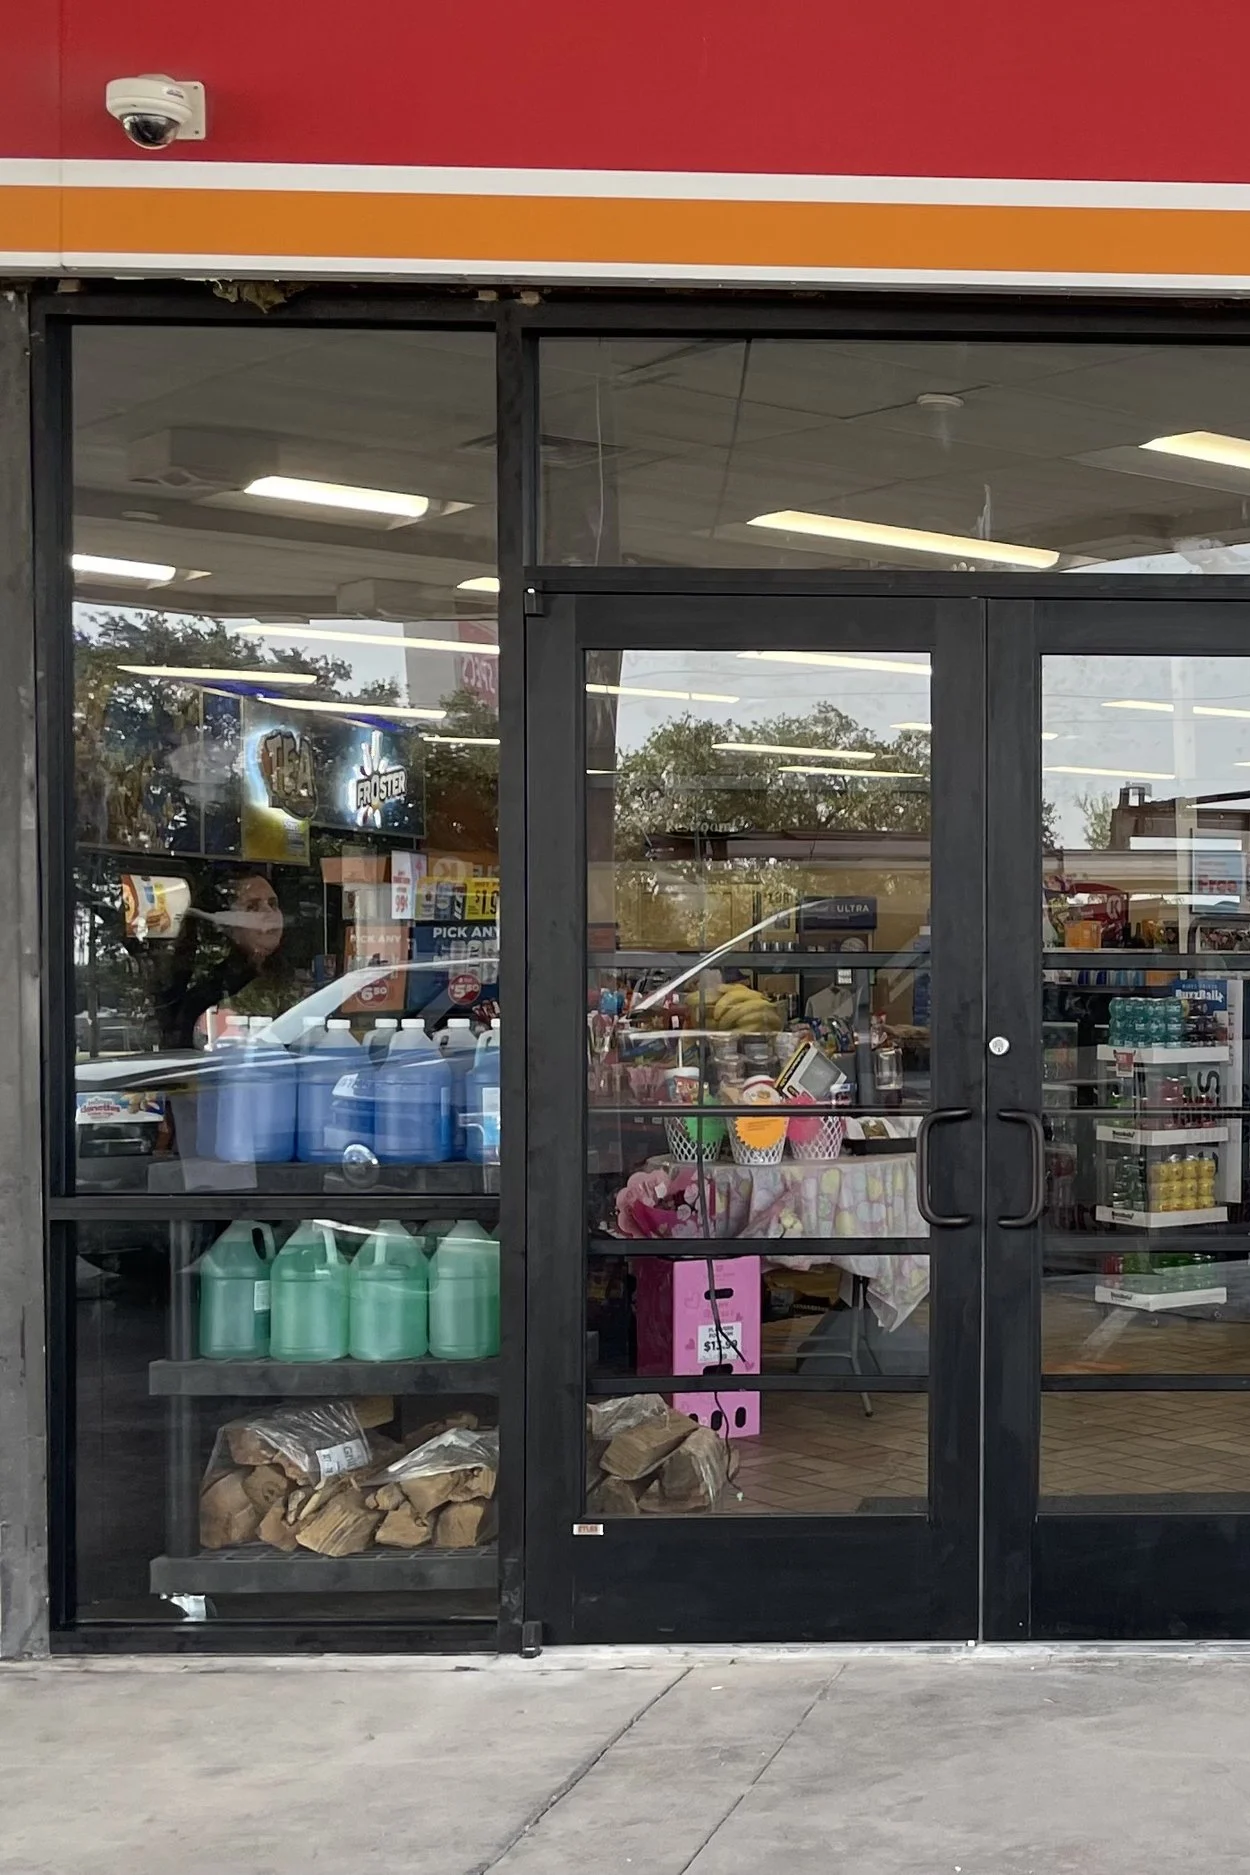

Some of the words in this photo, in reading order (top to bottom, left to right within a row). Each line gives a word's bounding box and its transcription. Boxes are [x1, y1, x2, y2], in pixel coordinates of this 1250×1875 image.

[265, 734, 313, 799] TEA
[357, 771, 406, 808] FROSTER
[836, 904, 869, 913] ULTRA
[433, 926, 467, 938] PICK
[381, 935, 401, 944] ANY
